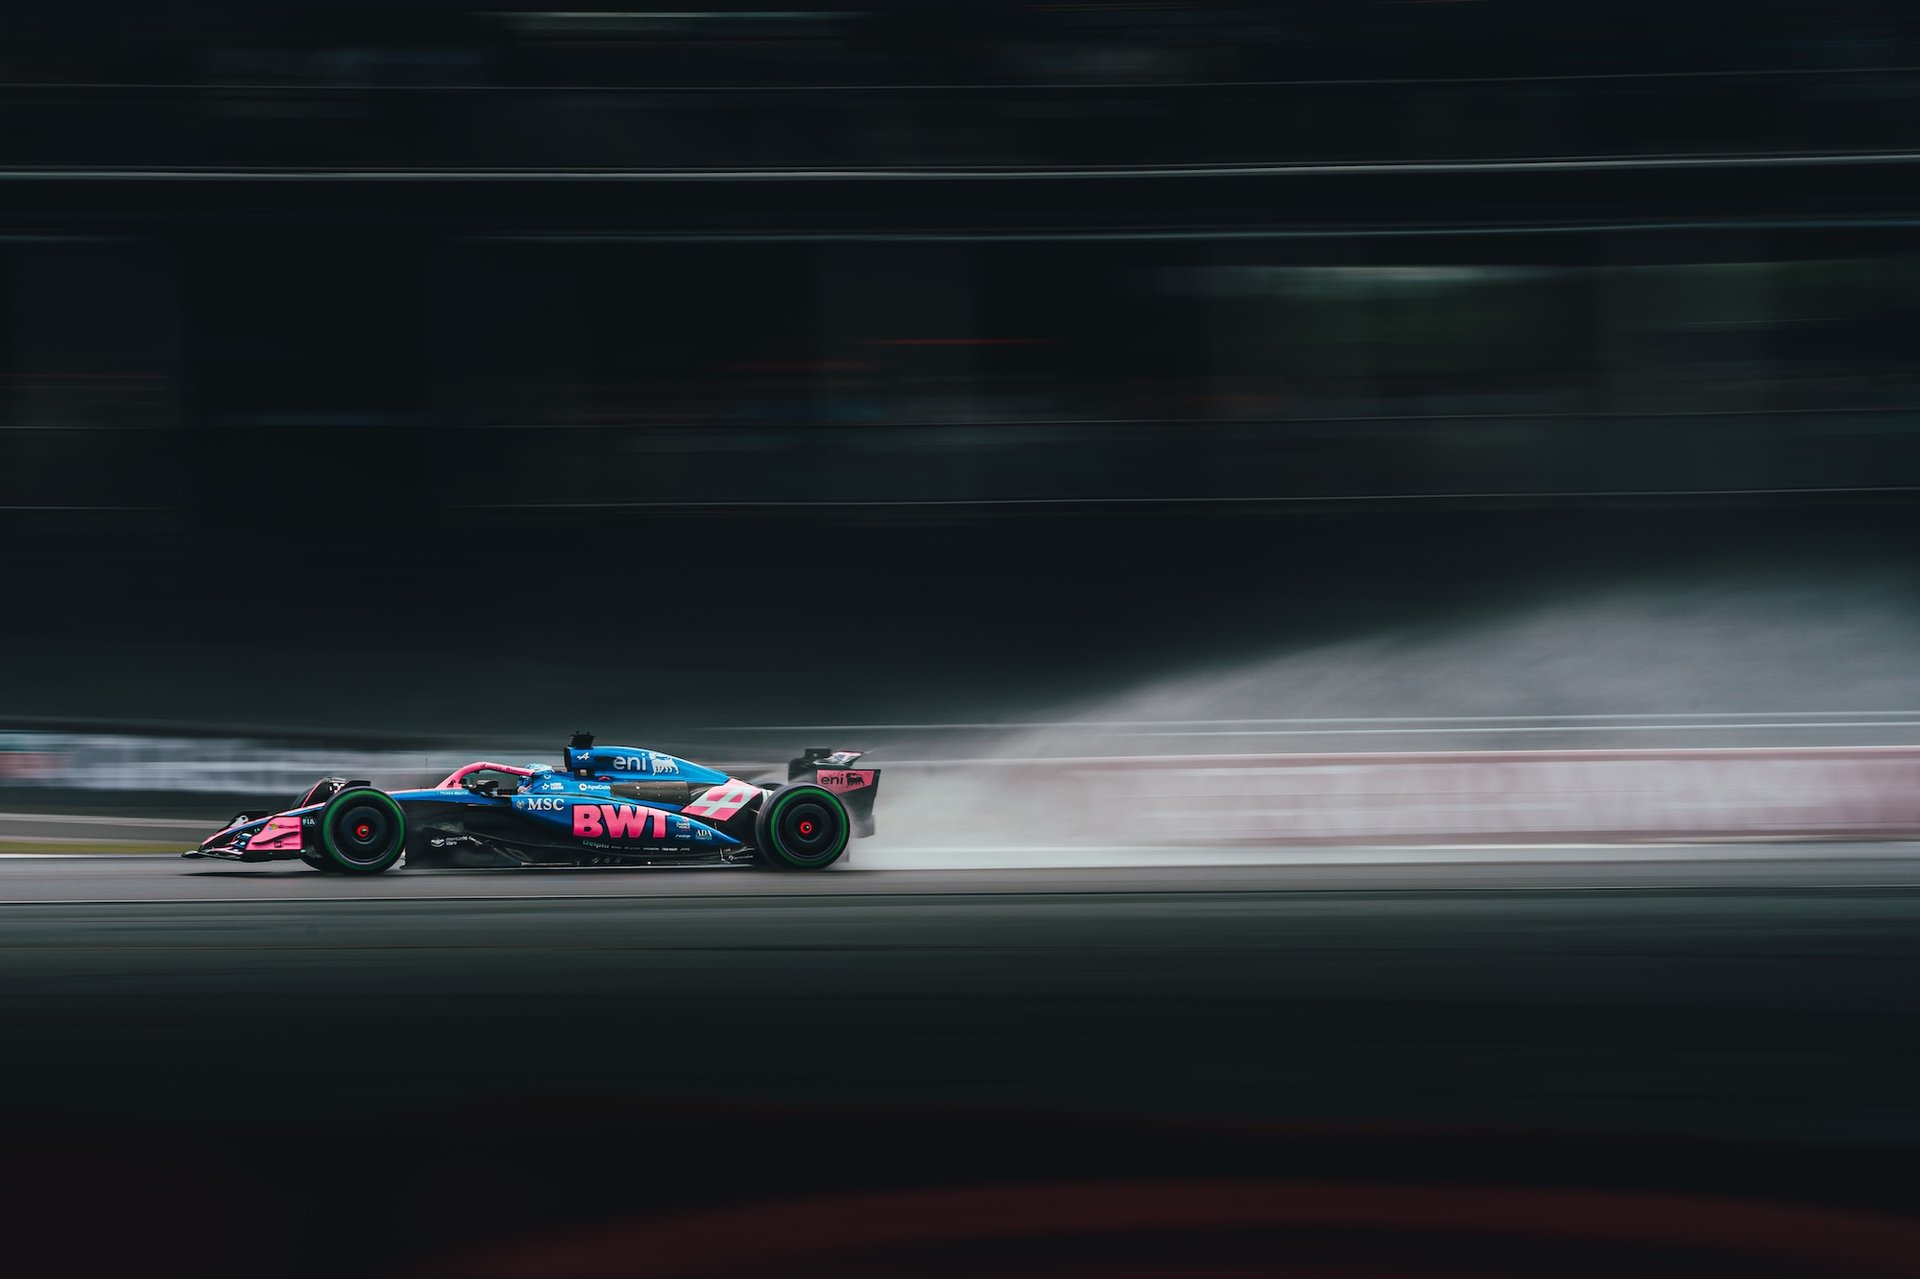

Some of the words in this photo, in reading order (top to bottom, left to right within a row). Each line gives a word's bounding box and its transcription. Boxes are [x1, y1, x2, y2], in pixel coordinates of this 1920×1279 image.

[612, 752, 647, 771] eni
[821, 774, 844, 785] eni
[527, 798, 565, 811] MSC
[573, 804, 670, 838] BWT
[697, 829, 712, 837] ADA
